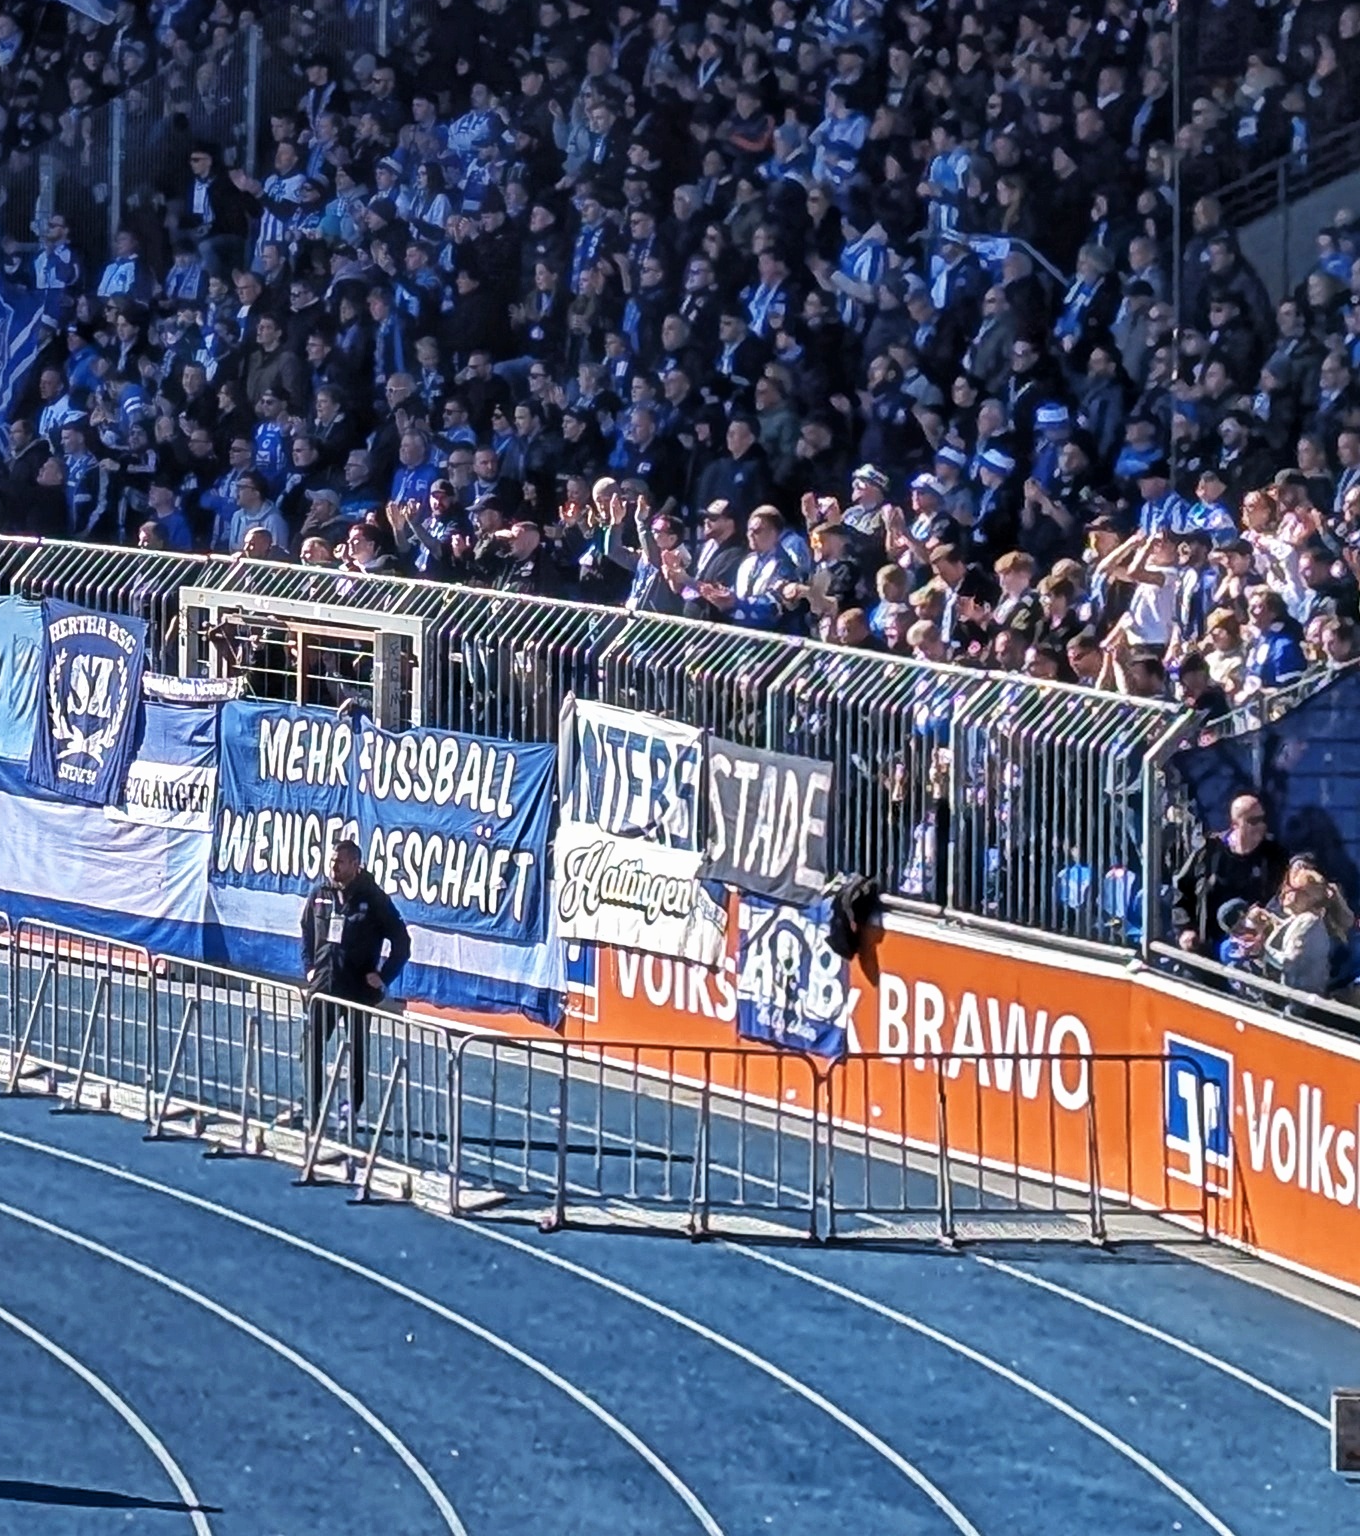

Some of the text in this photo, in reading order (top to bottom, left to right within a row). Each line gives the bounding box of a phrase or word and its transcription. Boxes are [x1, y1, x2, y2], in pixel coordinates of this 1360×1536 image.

[49, 615, 108, 644] HERTHA
[258, 717, 517, 821] MEHR FUSSBALL
[369, 825, 535, 922] GESCHÄFT
[880, 974, 1093, 1111] BRAWO
[1242, 1069, 1360, 1209] Volks
